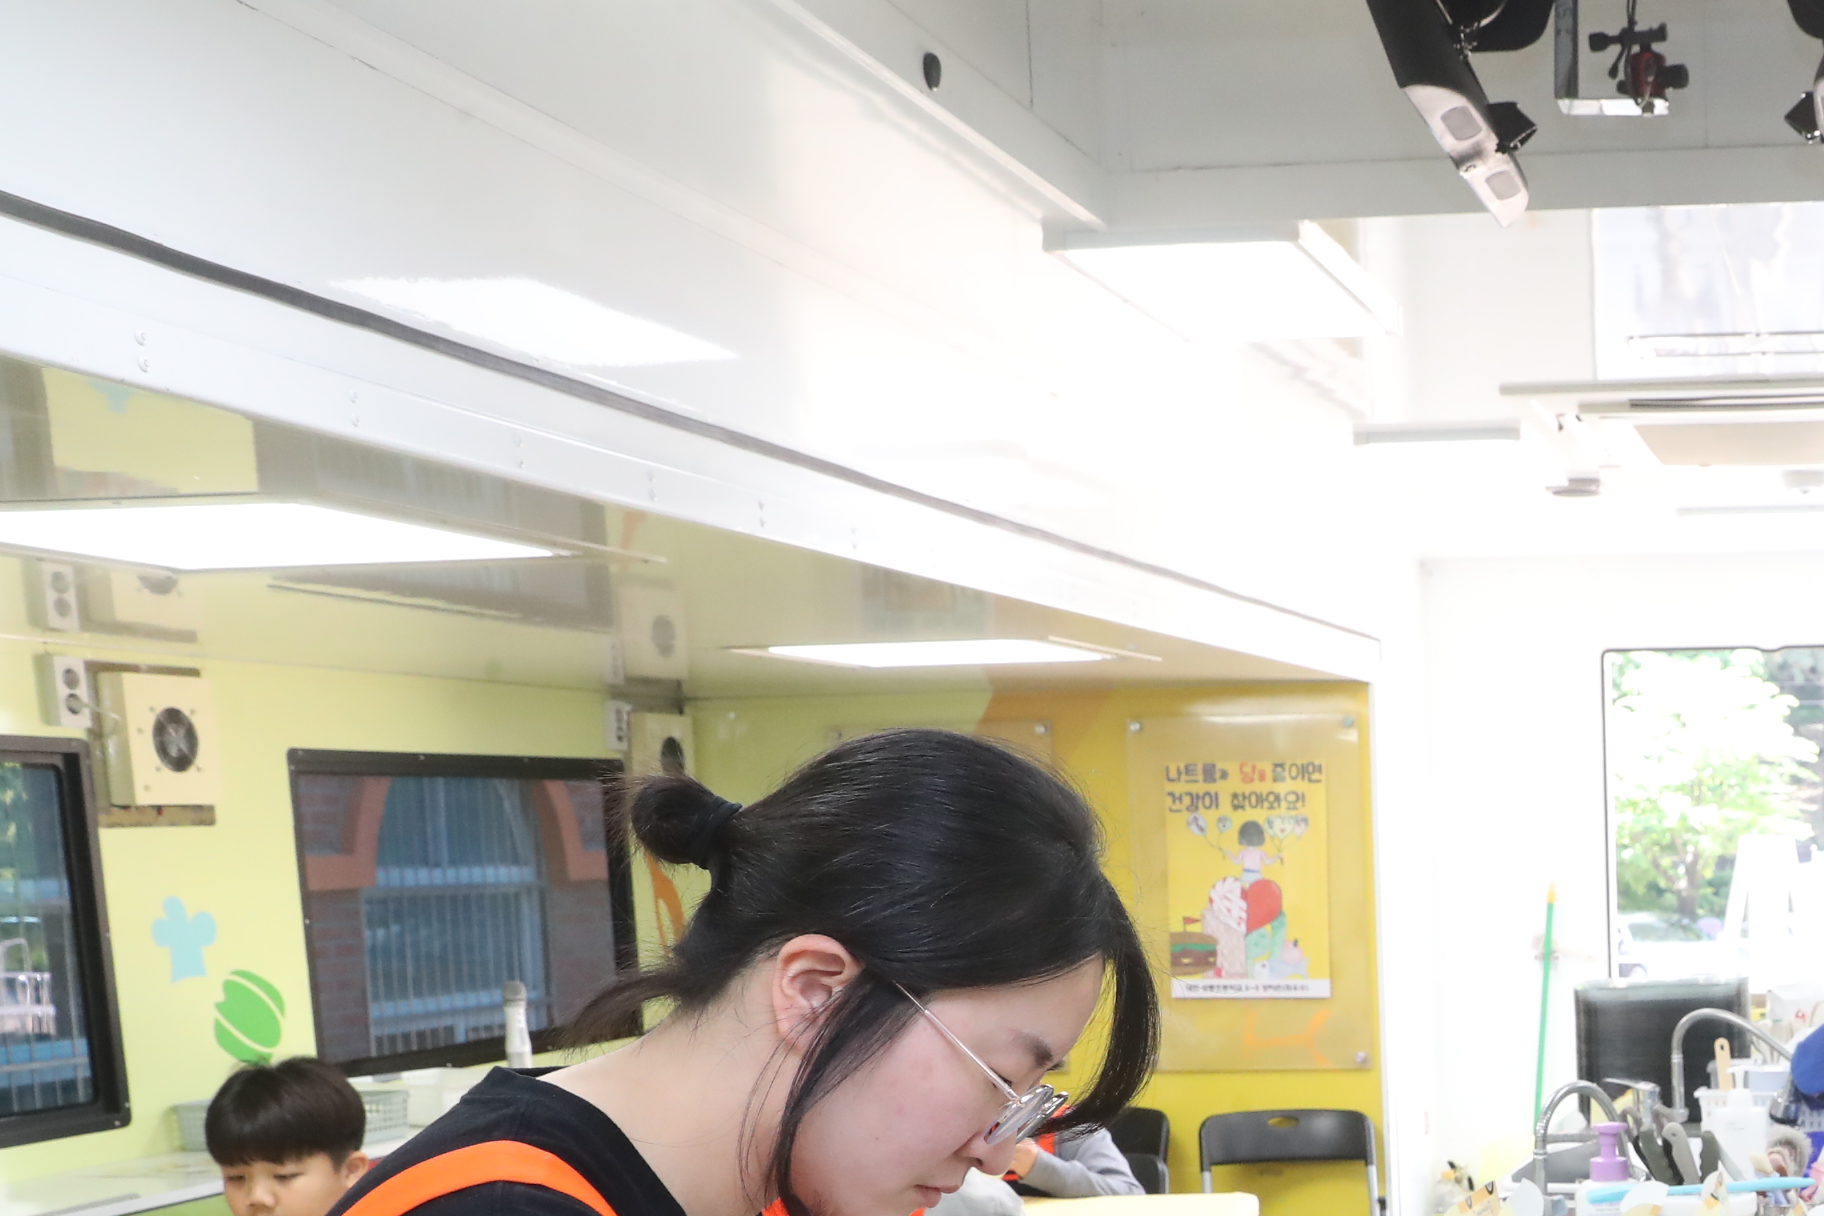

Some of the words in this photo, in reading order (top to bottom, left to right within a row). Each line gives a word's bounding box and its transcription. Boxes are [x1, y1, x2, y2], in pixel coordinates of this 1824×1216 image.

[1272, 761, 1323, 784] 줄이면
[1167, 791, 1220, 813] 건강이
[1231, 790, 1306, 812] 찾아와요!
